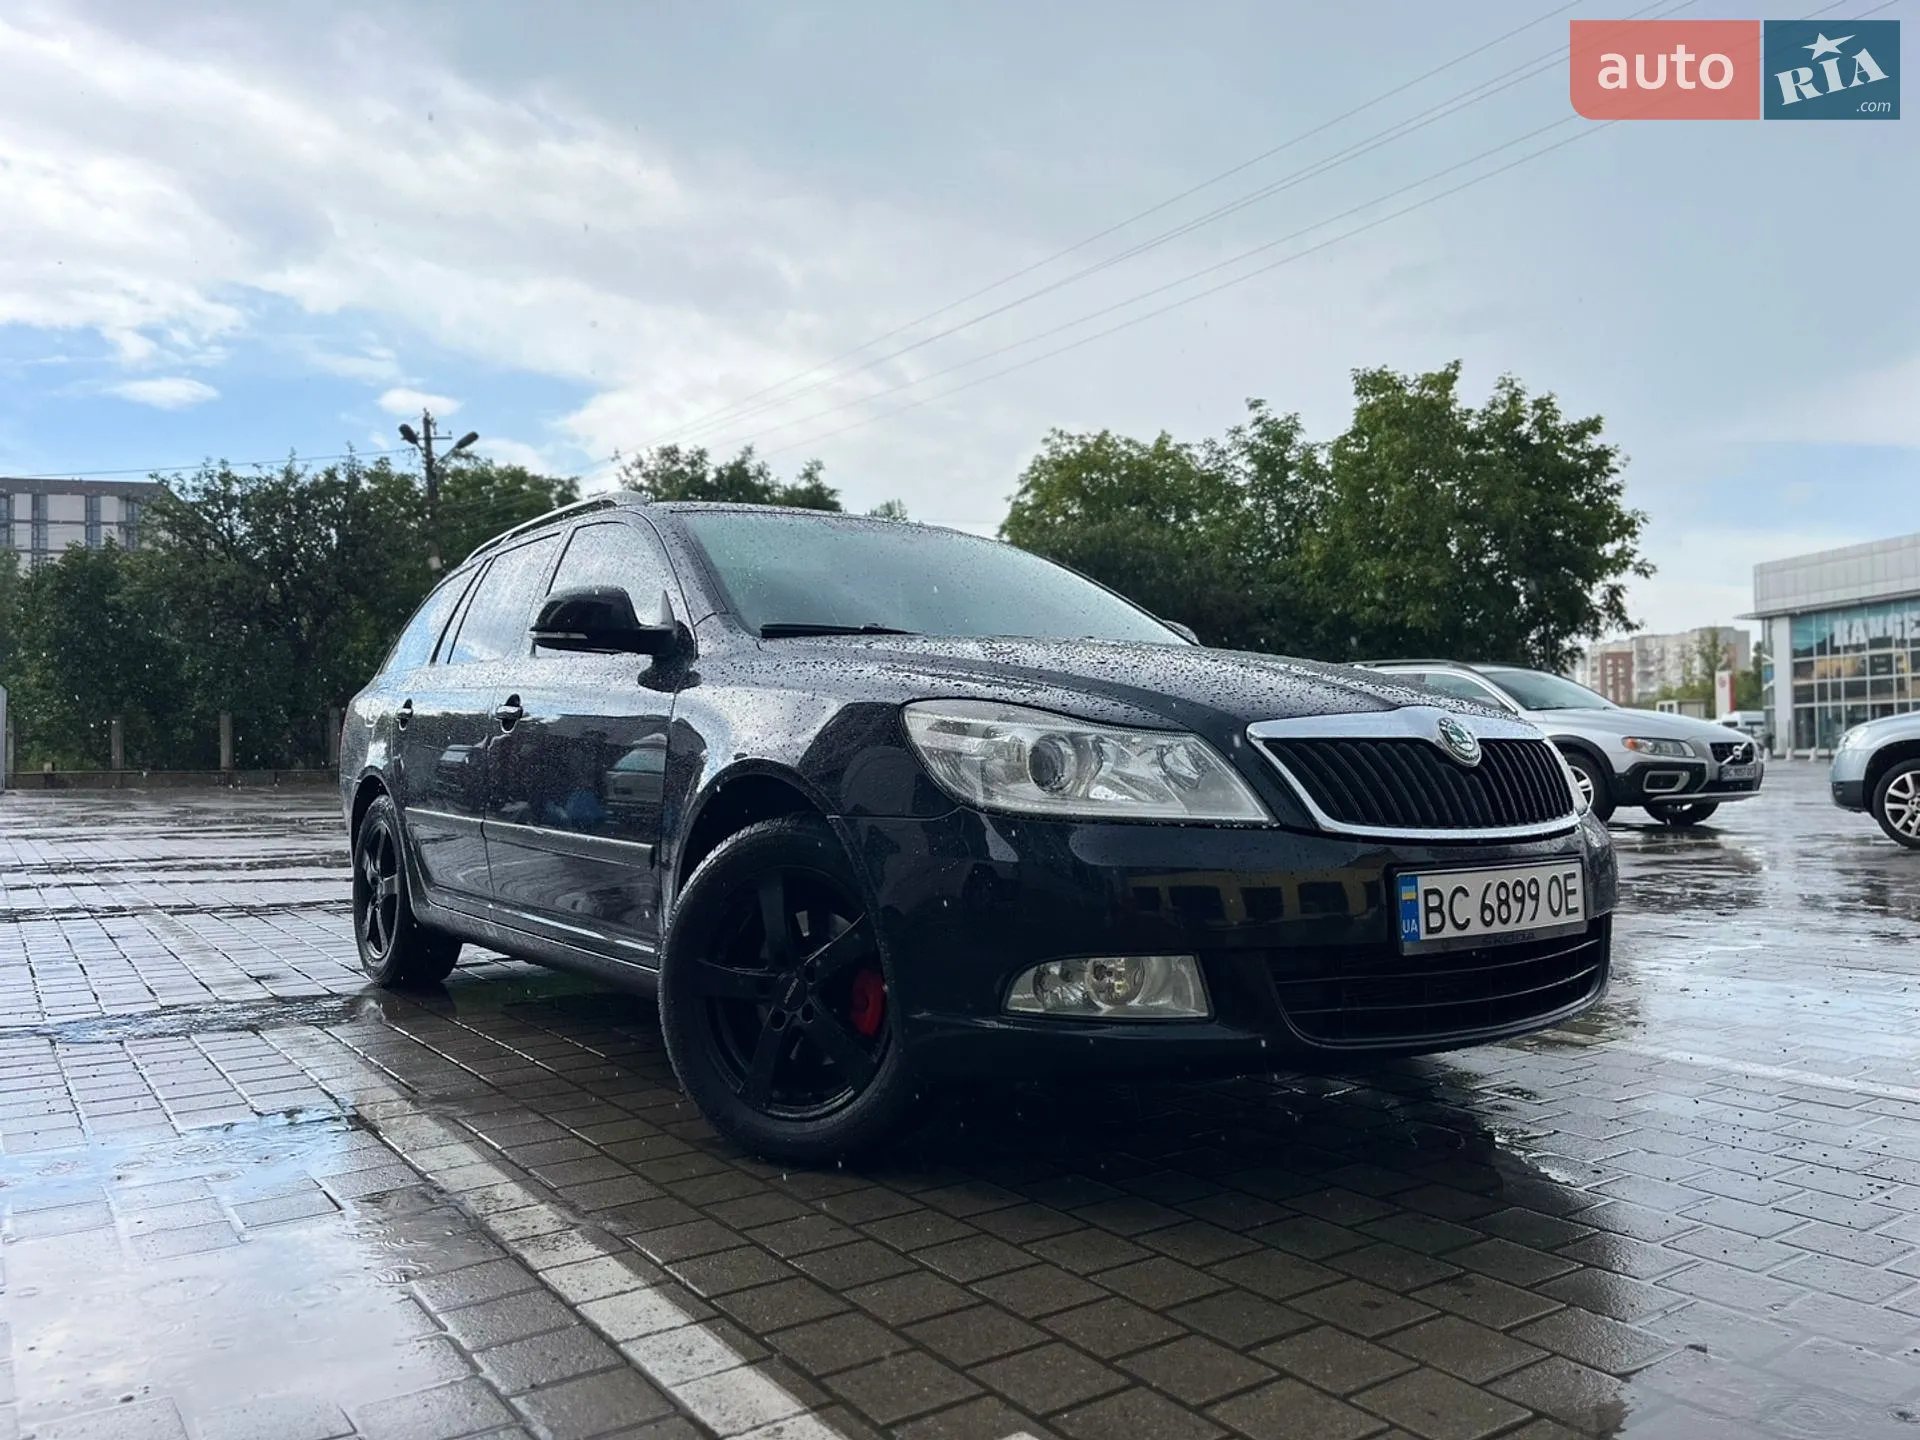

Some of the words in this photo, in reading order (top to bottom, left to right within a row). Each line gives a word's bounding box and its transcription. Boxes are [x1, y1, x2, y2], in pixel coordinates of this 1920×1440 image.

[1423, 886, 1470, 934] BC
[1480, 878, 1540, 927] 6899
[1547, 872, 1579, 917] OE
[1402, 919, 1418, 933] UA
